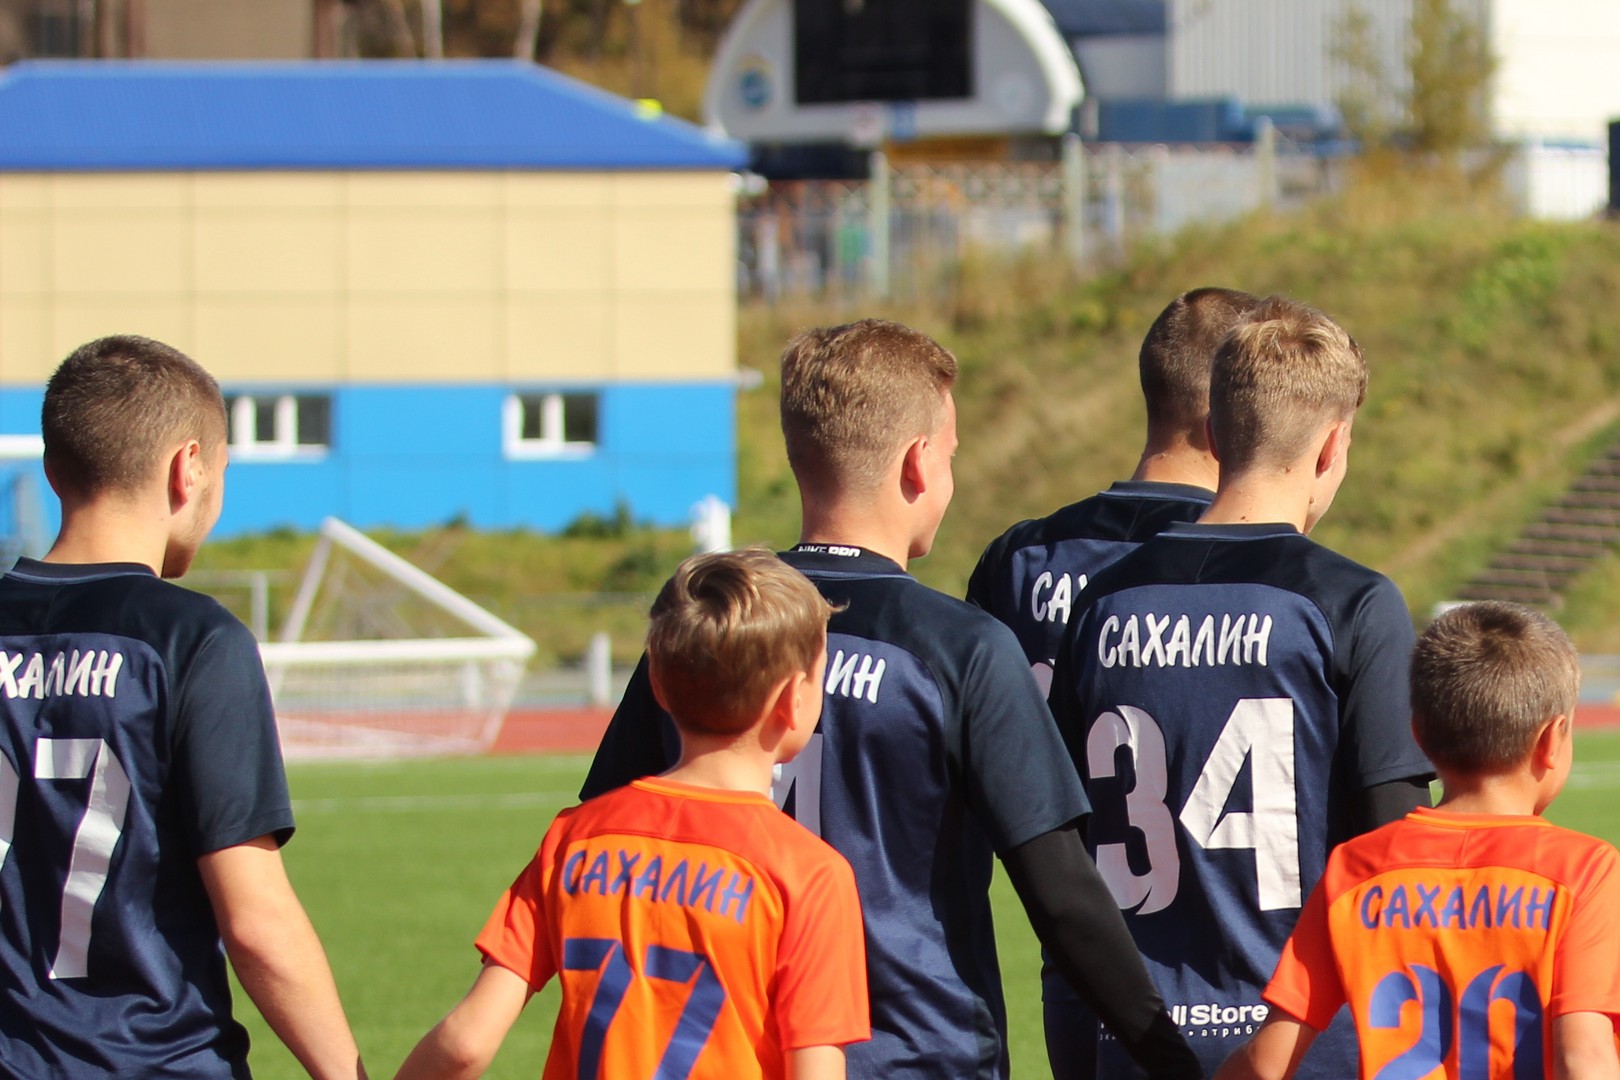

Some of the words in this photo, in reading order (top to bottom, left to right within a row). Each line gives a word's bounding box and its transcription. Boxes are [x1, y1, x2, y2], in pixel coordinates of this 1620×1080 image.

[1031, 571, 1089, 625] СА
[1099, 613, 1273, 668] САХАЛИН
[1086, 697, 1302, 915] 34
[562, 849, 755, 925] САХАЛИН
[1361, 882, 1556, 932] САХАЛИН
